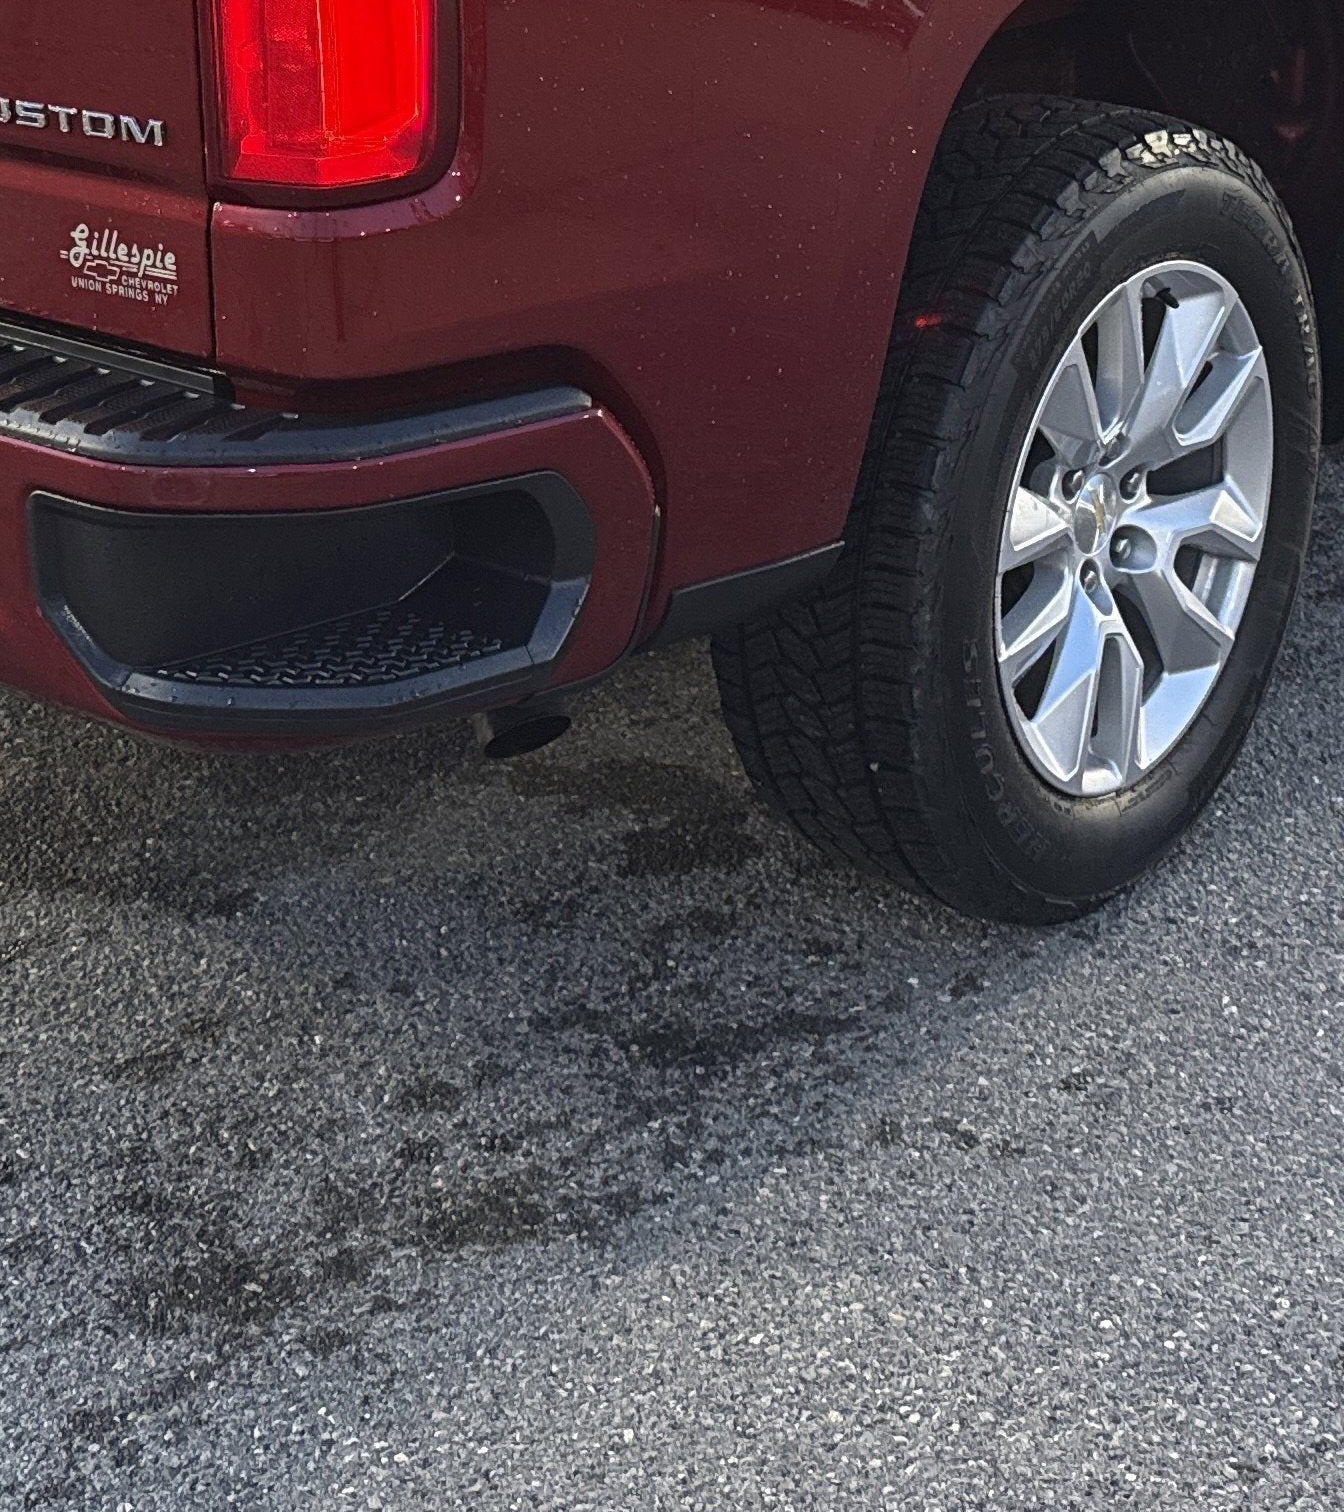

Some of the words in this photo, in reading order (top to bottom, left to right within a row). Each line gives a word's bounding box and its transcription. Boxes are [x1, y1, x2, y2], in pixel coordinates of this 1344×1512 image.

[70, 223, 177, 278] Gillespie
[71, 275, 102, 292] UNION
[105, 283, 149, 302] SPRINGS
[155, 292, 169, 305] NY
[121, 274, 178, 296] CHEVROLET
